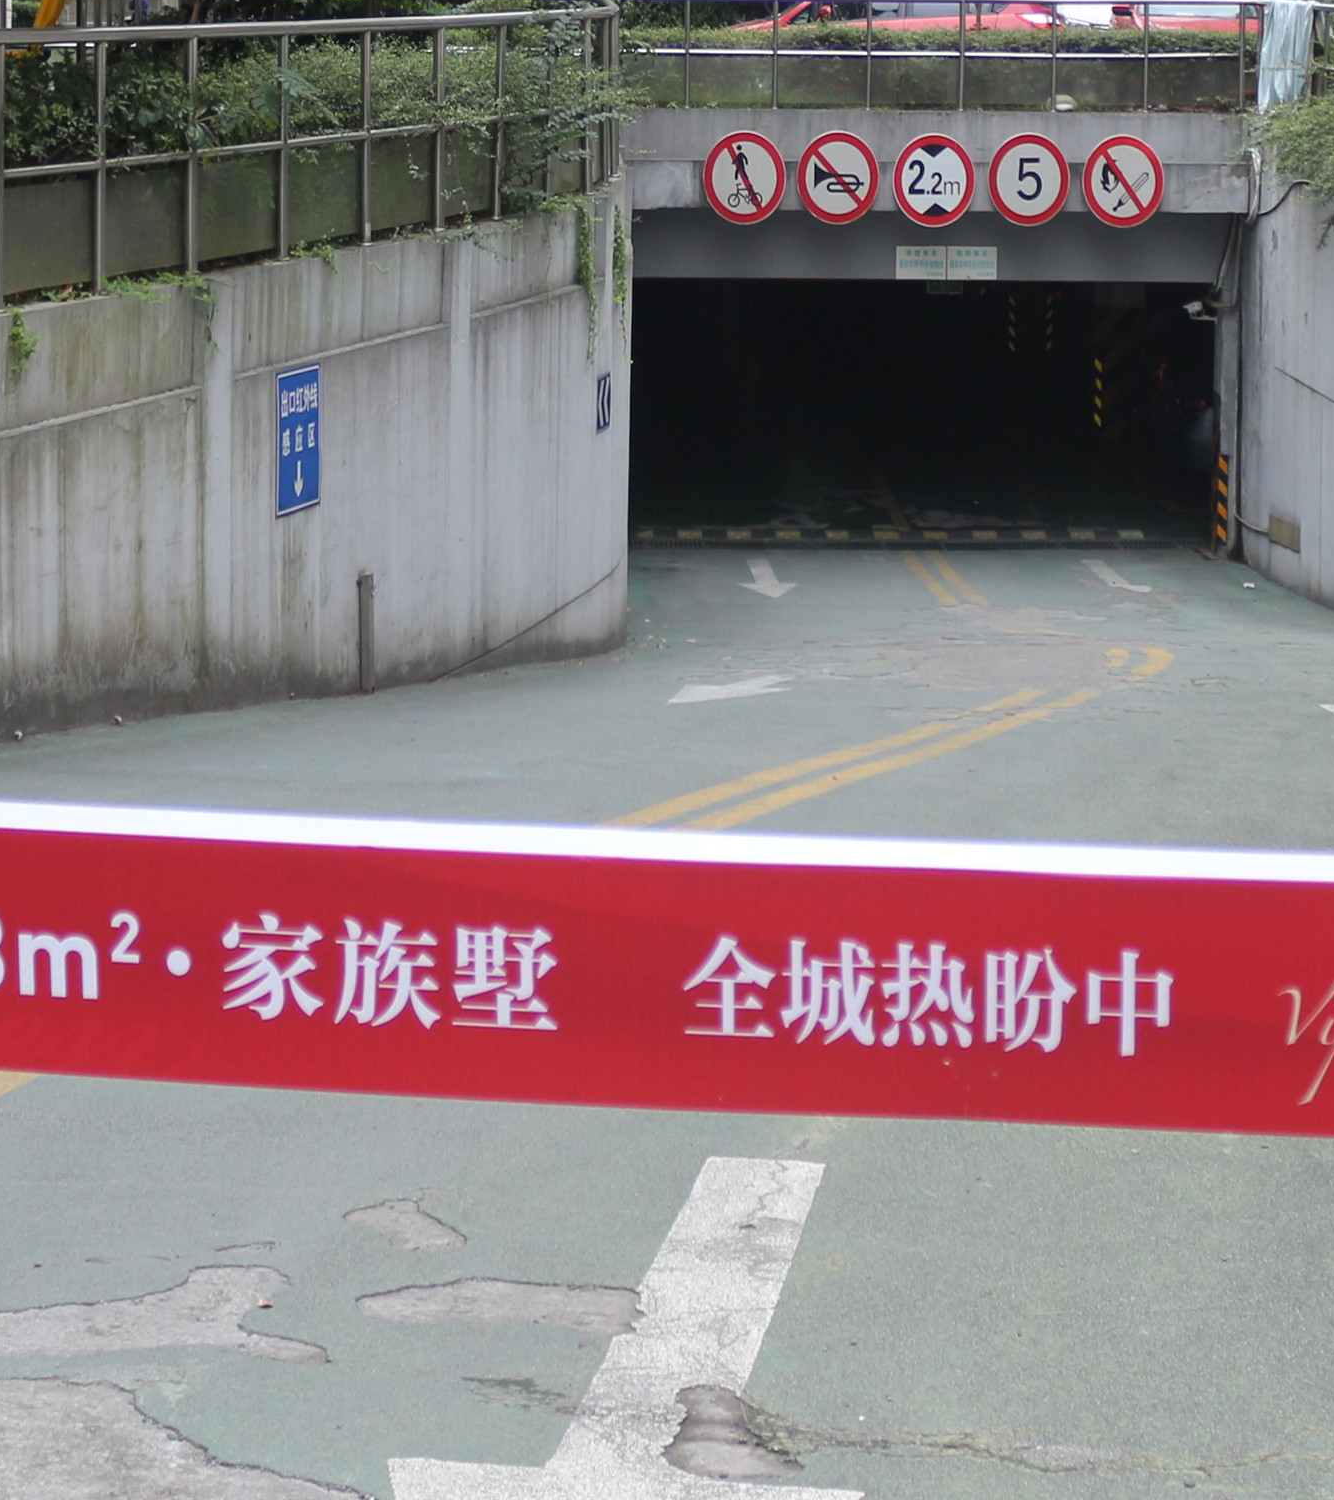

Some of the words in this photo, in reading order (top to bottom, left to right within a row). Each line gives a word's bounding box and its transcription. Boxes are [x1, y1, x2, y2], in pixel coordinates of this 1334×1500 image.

[908, 159, 961, 195] 2.2m
[1017, 157, 1043, 201] 5
[281, 382, 318, 418] 出口红外线
[282, 422, 316, 457] 感应区
[683, 934, 1173, 1057] 全城热盼中
